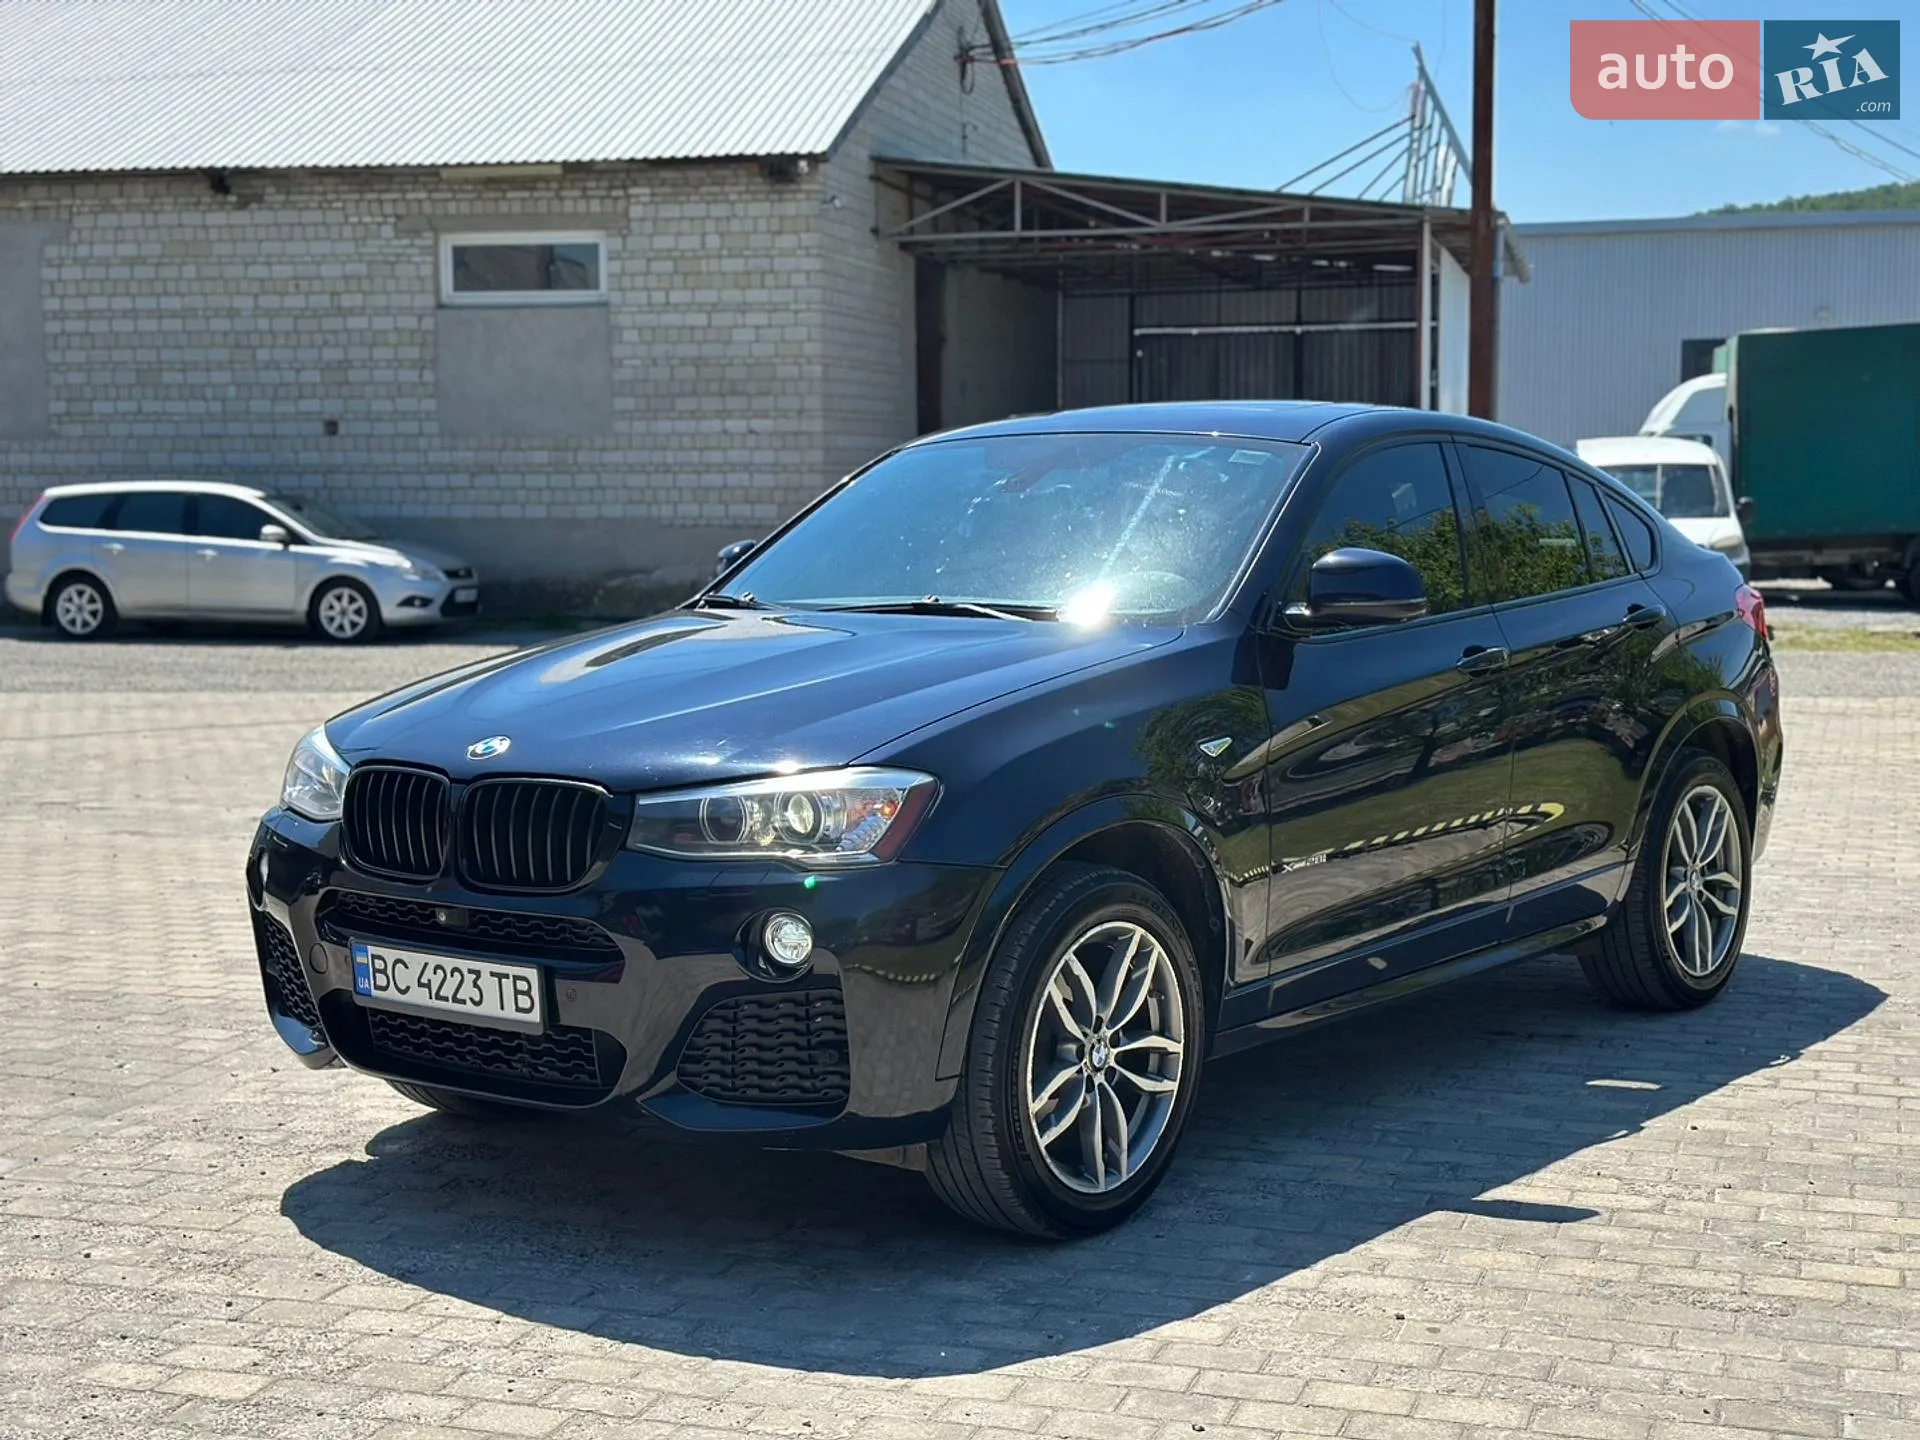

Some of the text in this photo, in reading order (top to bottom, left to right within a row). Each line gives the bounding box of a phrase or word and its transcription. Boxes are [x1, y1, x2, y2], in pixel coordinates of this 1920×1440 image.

[358, 976, 370, 989] UA
[371, 954, 535, 1014] BC 4223 TB
